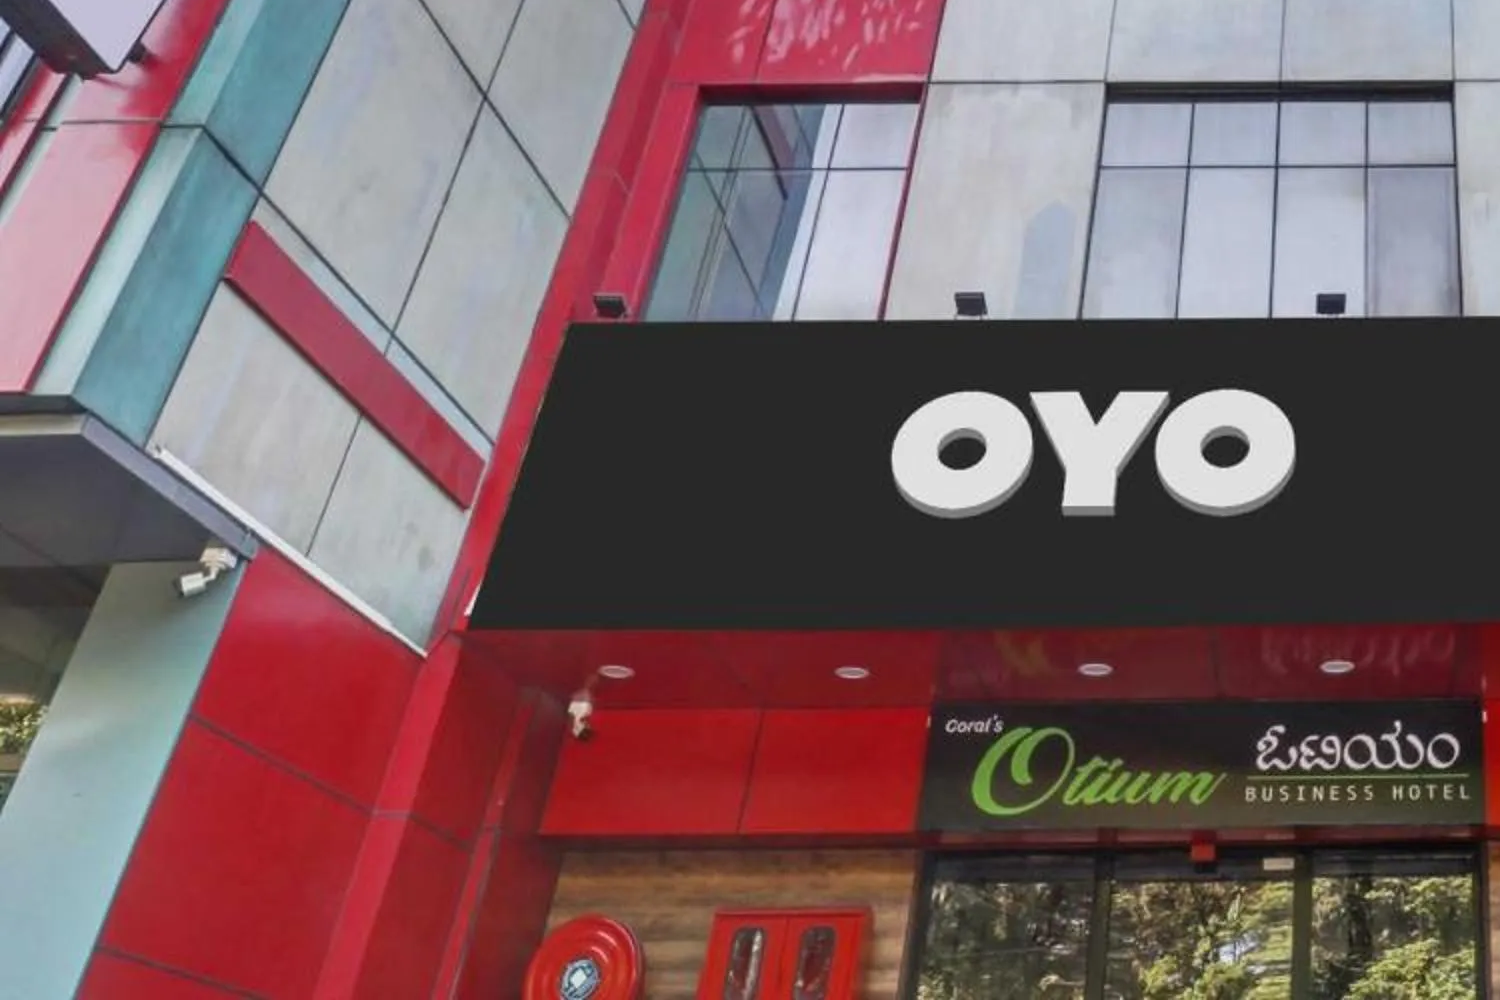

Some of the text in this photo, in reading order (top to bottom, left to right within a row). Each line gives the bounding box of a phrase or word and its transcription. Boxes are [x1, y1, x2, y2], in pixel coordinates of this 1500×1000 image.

[891, 388, 1297, 519] OYO
[944, 714, 1005, 734] Coral's
[971, 726, 1228, 816] Otium
[1244, 783, 1472, 802] BUSINESS HOTEL
